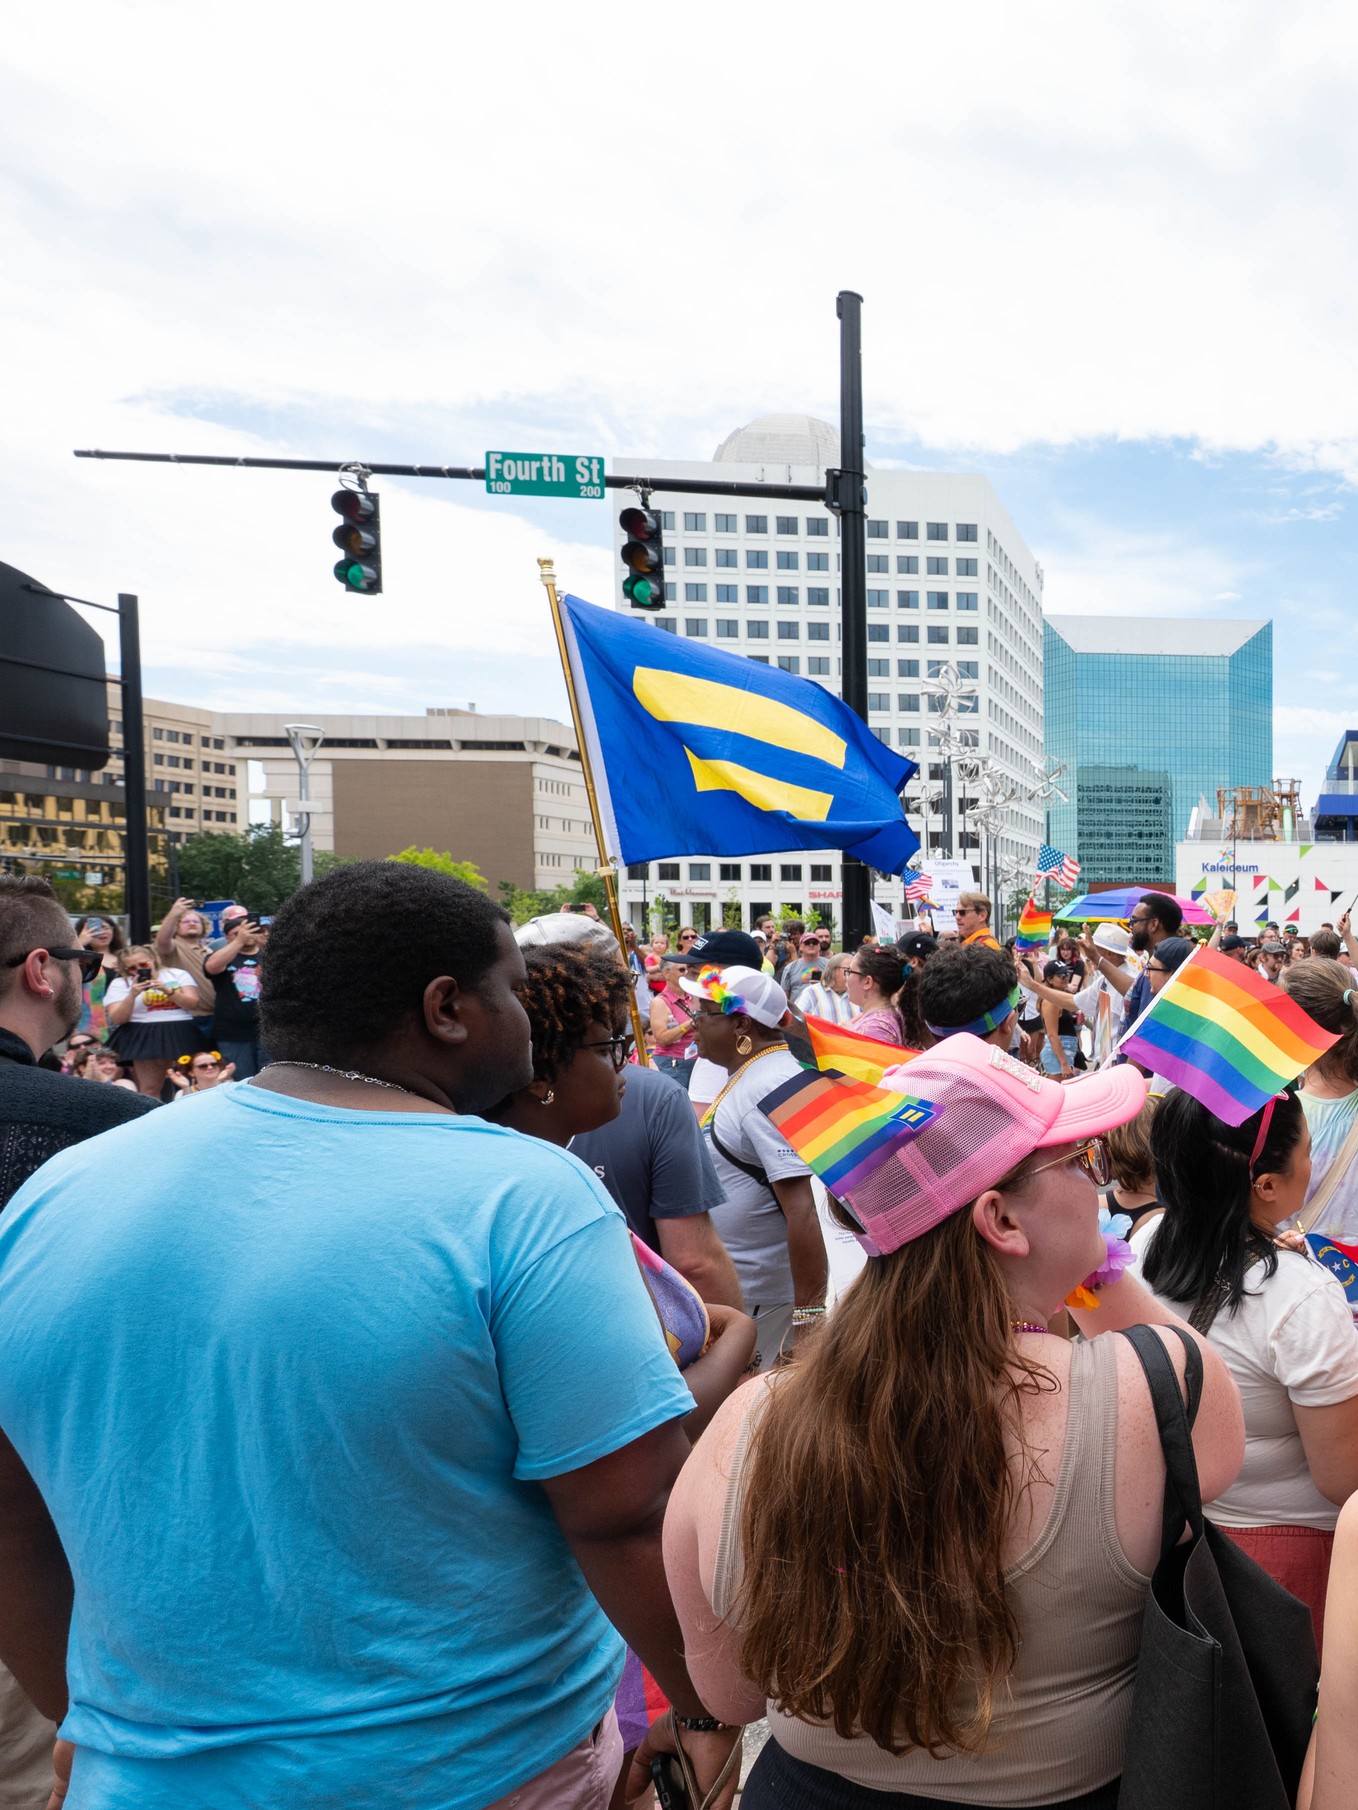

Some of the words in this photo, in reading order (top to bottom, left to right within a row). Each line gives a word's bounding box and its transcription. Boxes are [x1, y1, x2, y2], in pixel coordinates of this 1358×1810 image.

[489, 453, 565, 482] Fourth
[575, 457, 600, 484] St
[490, 481, 511, 493] 100
[580, 486, 601, 497] 200
[1202, 863, 1259, 872] Kaleideum
